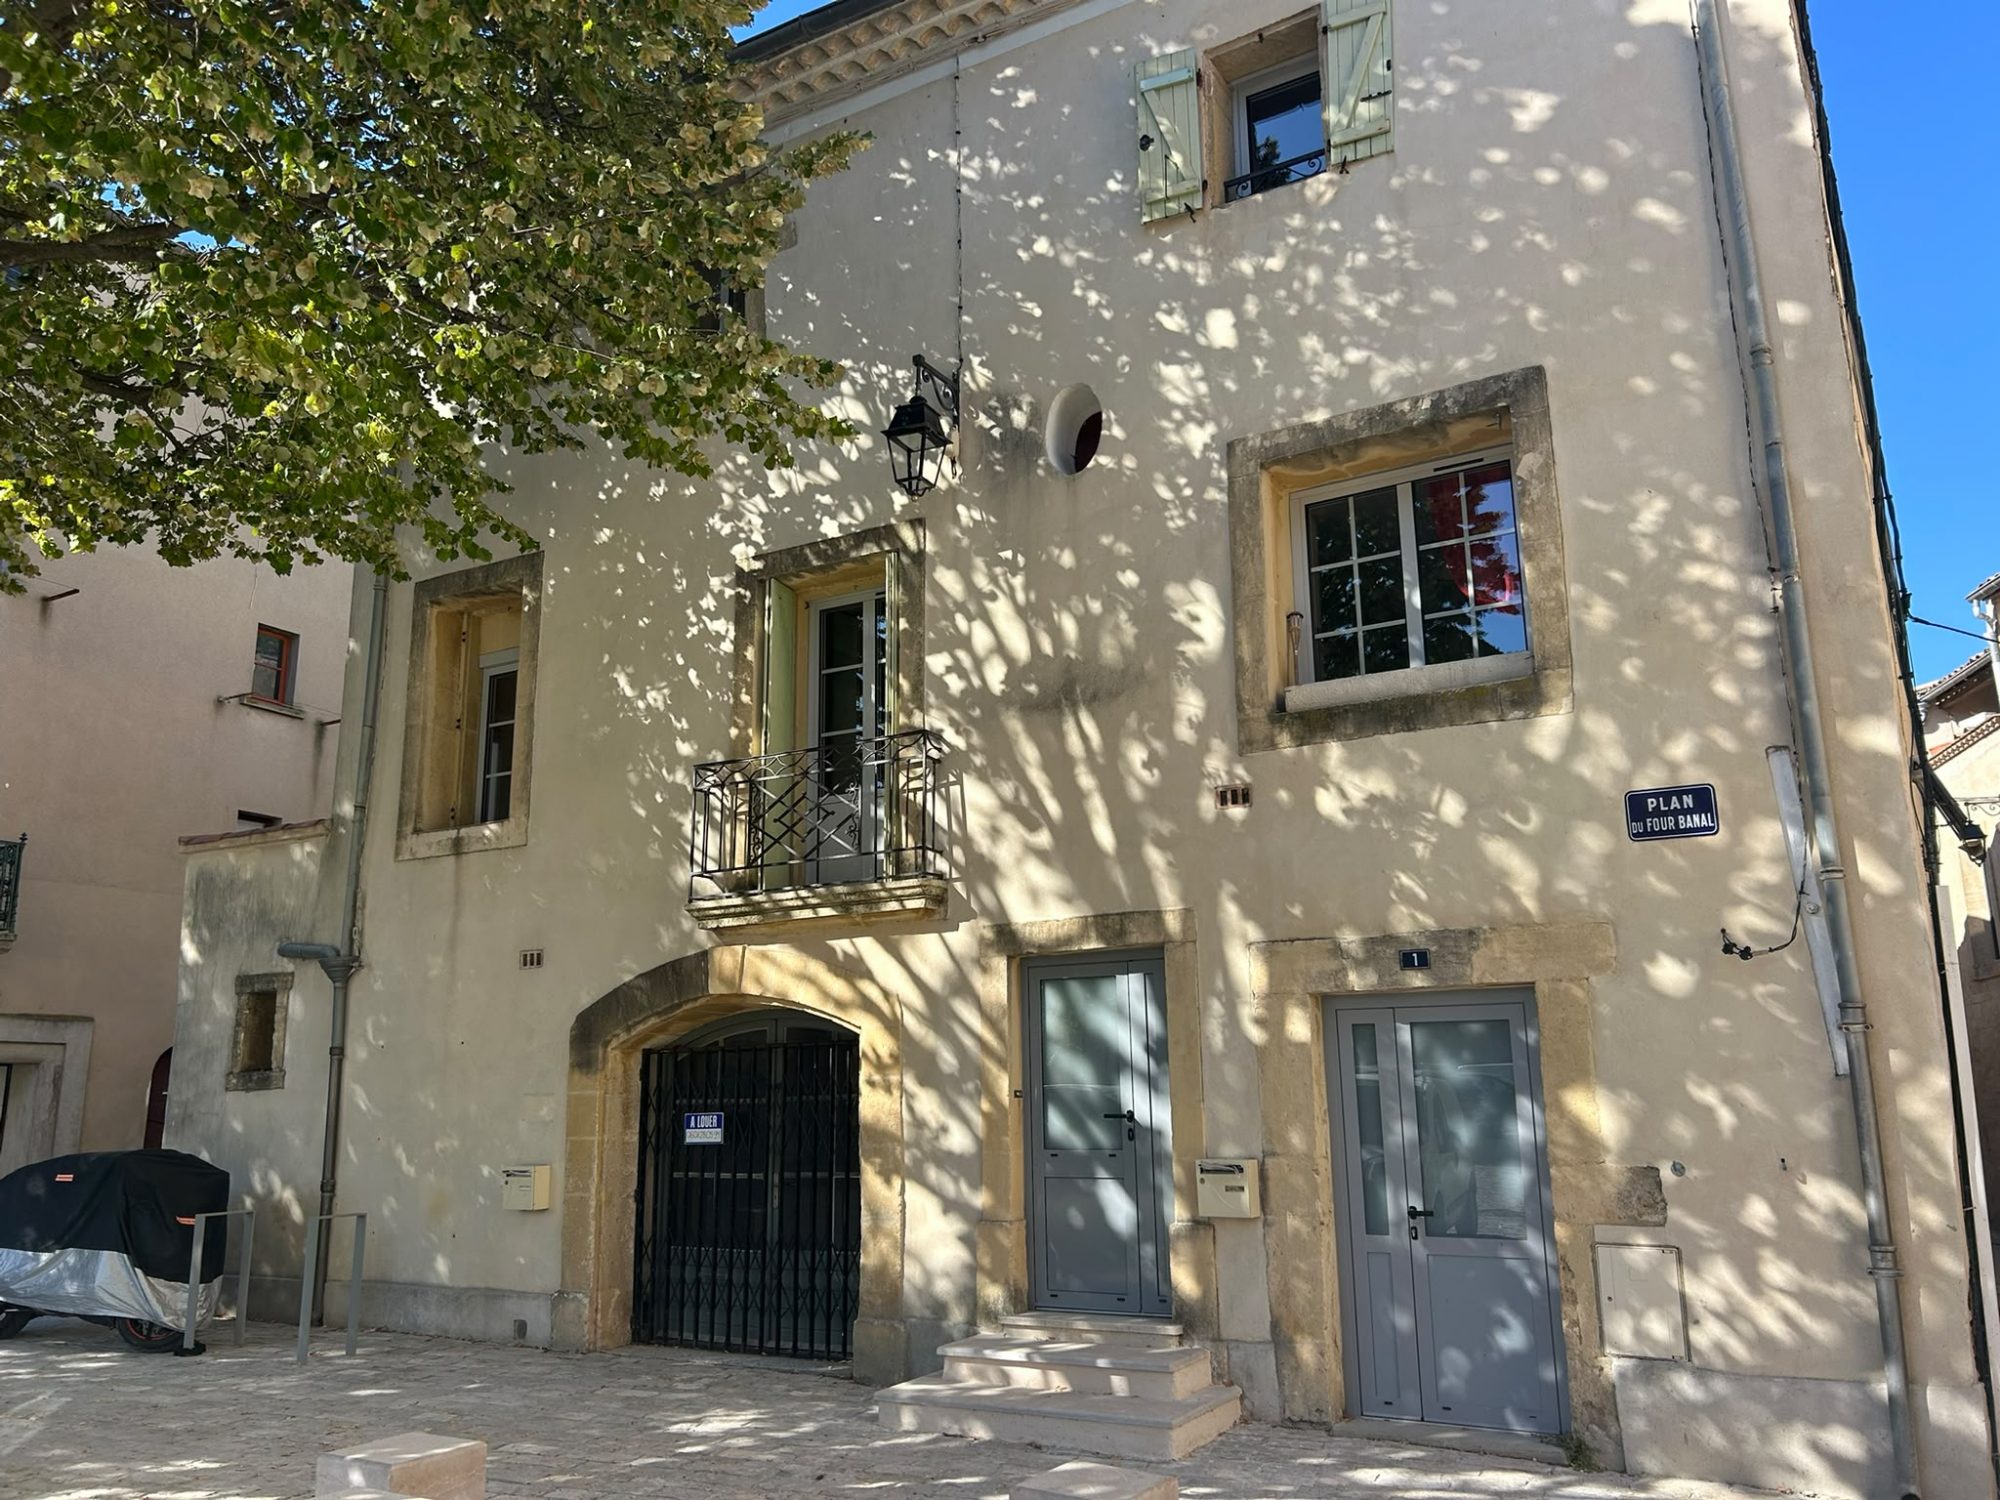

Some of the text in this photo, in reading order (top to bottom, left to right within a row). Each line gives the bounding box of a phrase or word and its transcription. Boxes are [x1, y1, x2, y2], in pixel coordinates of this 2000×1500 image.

[1647, 794, 1694, 812] PLAN
[1632, 812, 1715, 833] DU FOUR BANAL
[1412, 953, 1418, 966] 1
[690, 1115, 718, 1128] A LOUER
